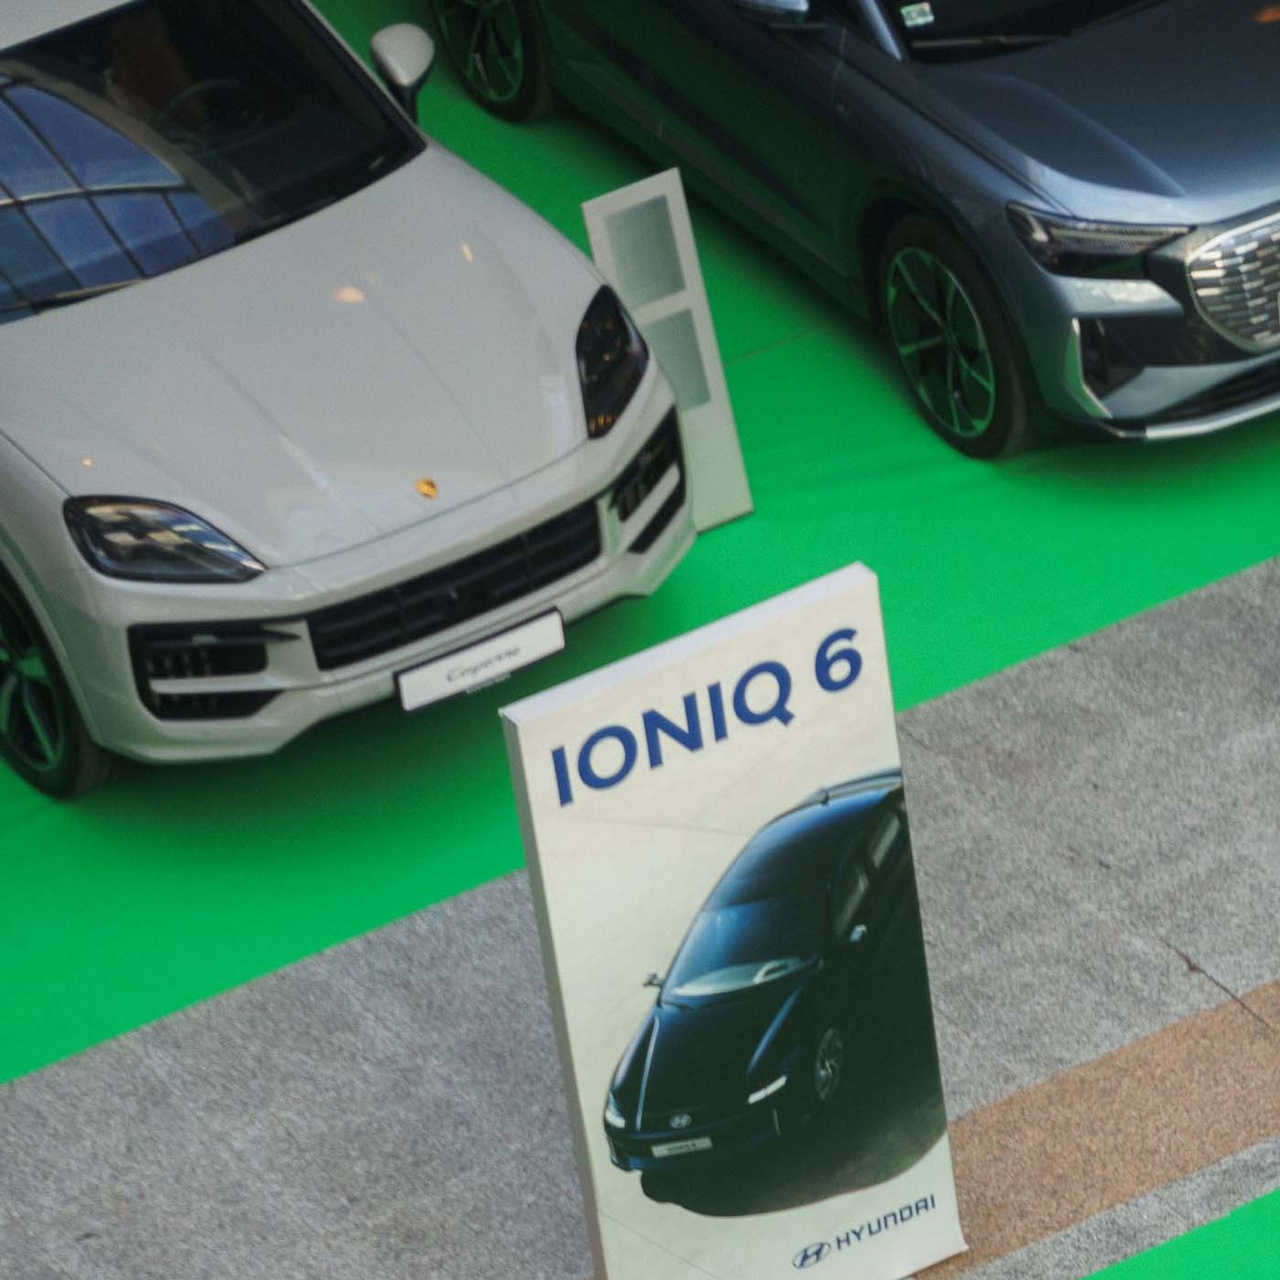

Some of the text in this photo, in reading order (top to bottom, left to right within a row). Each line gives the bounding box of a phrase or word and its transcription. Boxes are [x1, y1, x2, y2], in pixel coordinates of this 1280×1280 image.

[551, 627, 863, 808] IONIQ 6
[835, 1194, 936, 1251] HYUNDAI
